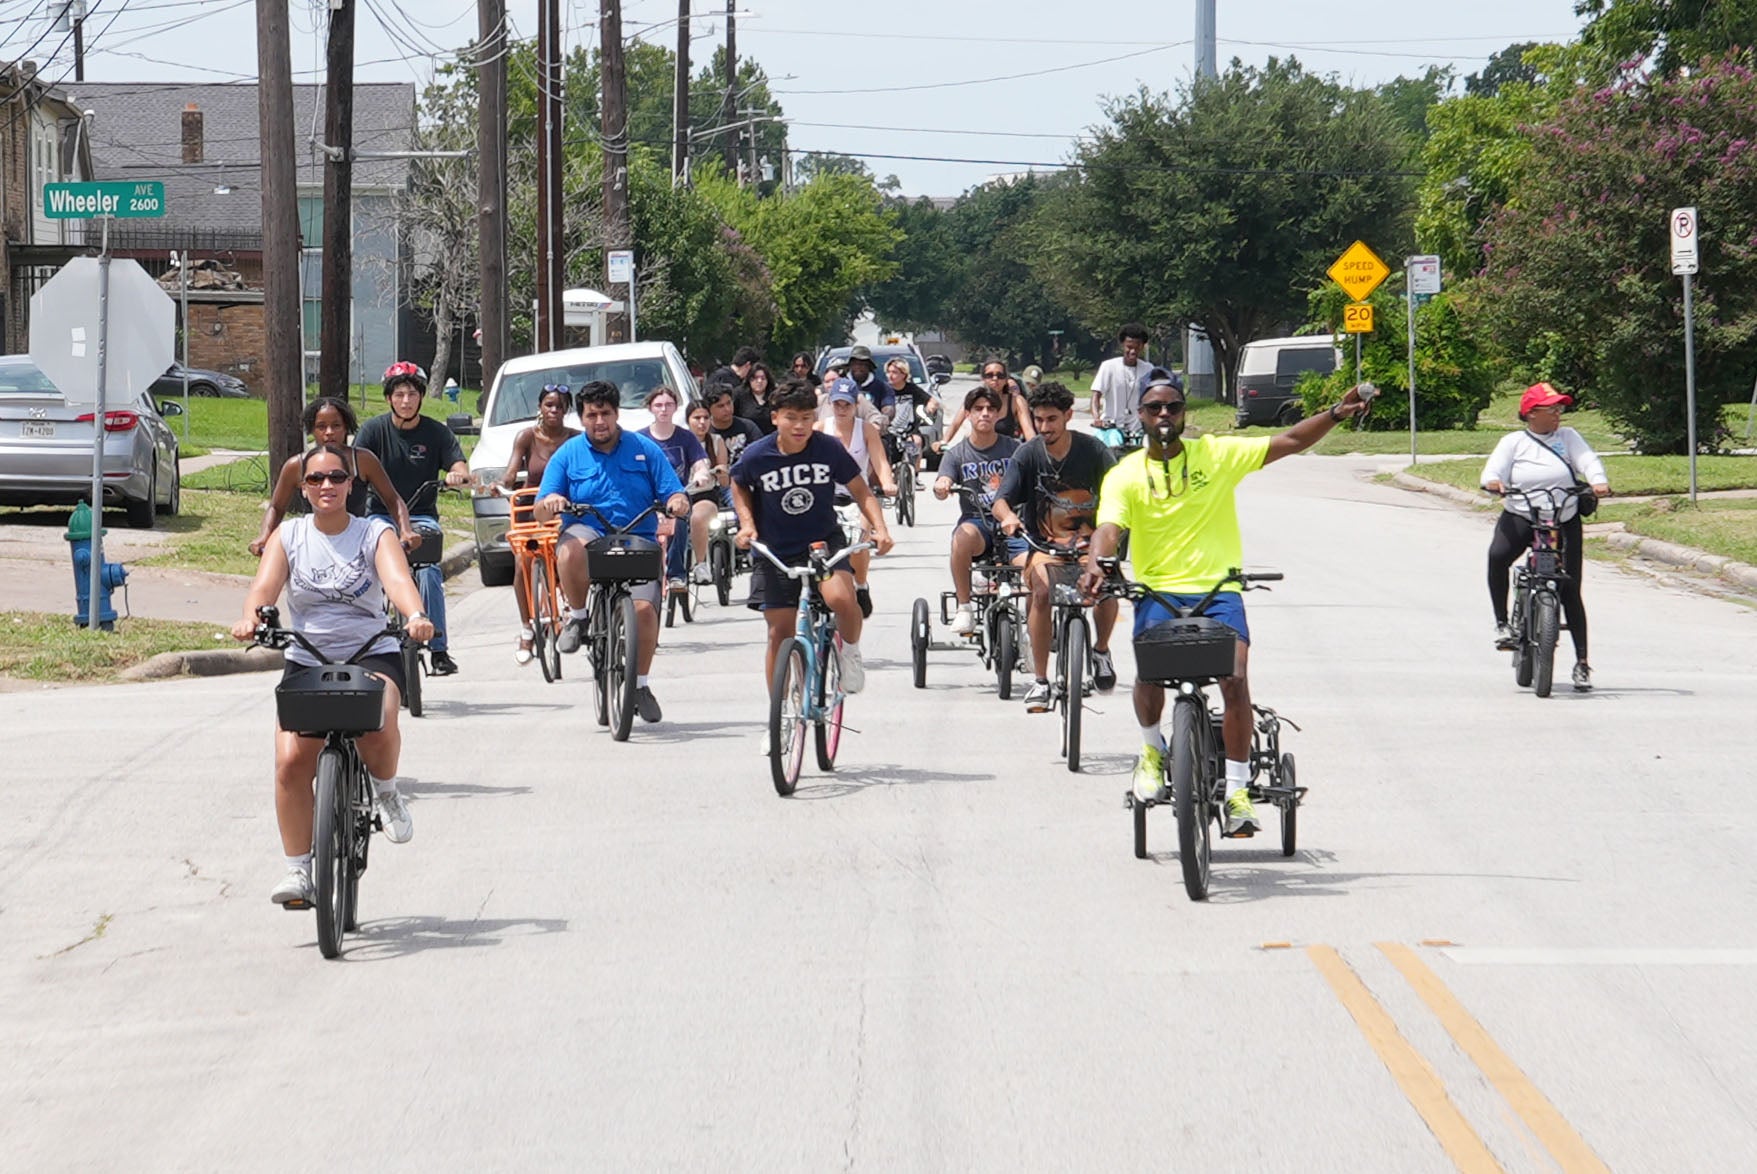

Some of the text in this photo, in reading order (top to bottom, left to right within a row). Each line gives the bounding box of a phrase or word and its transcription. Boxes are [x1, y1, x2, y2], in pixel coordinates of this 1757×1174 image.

[134, 184, 154, 196] AVE
[49, 189, 120, 212] Wheeler
[129, 198, 159, 211] 2600
[1343, 261, 1374, 271] SPEED
[1343, 275, 1373, 285] HUMP
[1347, 307, 1371, 321] 20
[760, 463, 830, 492] RICE
